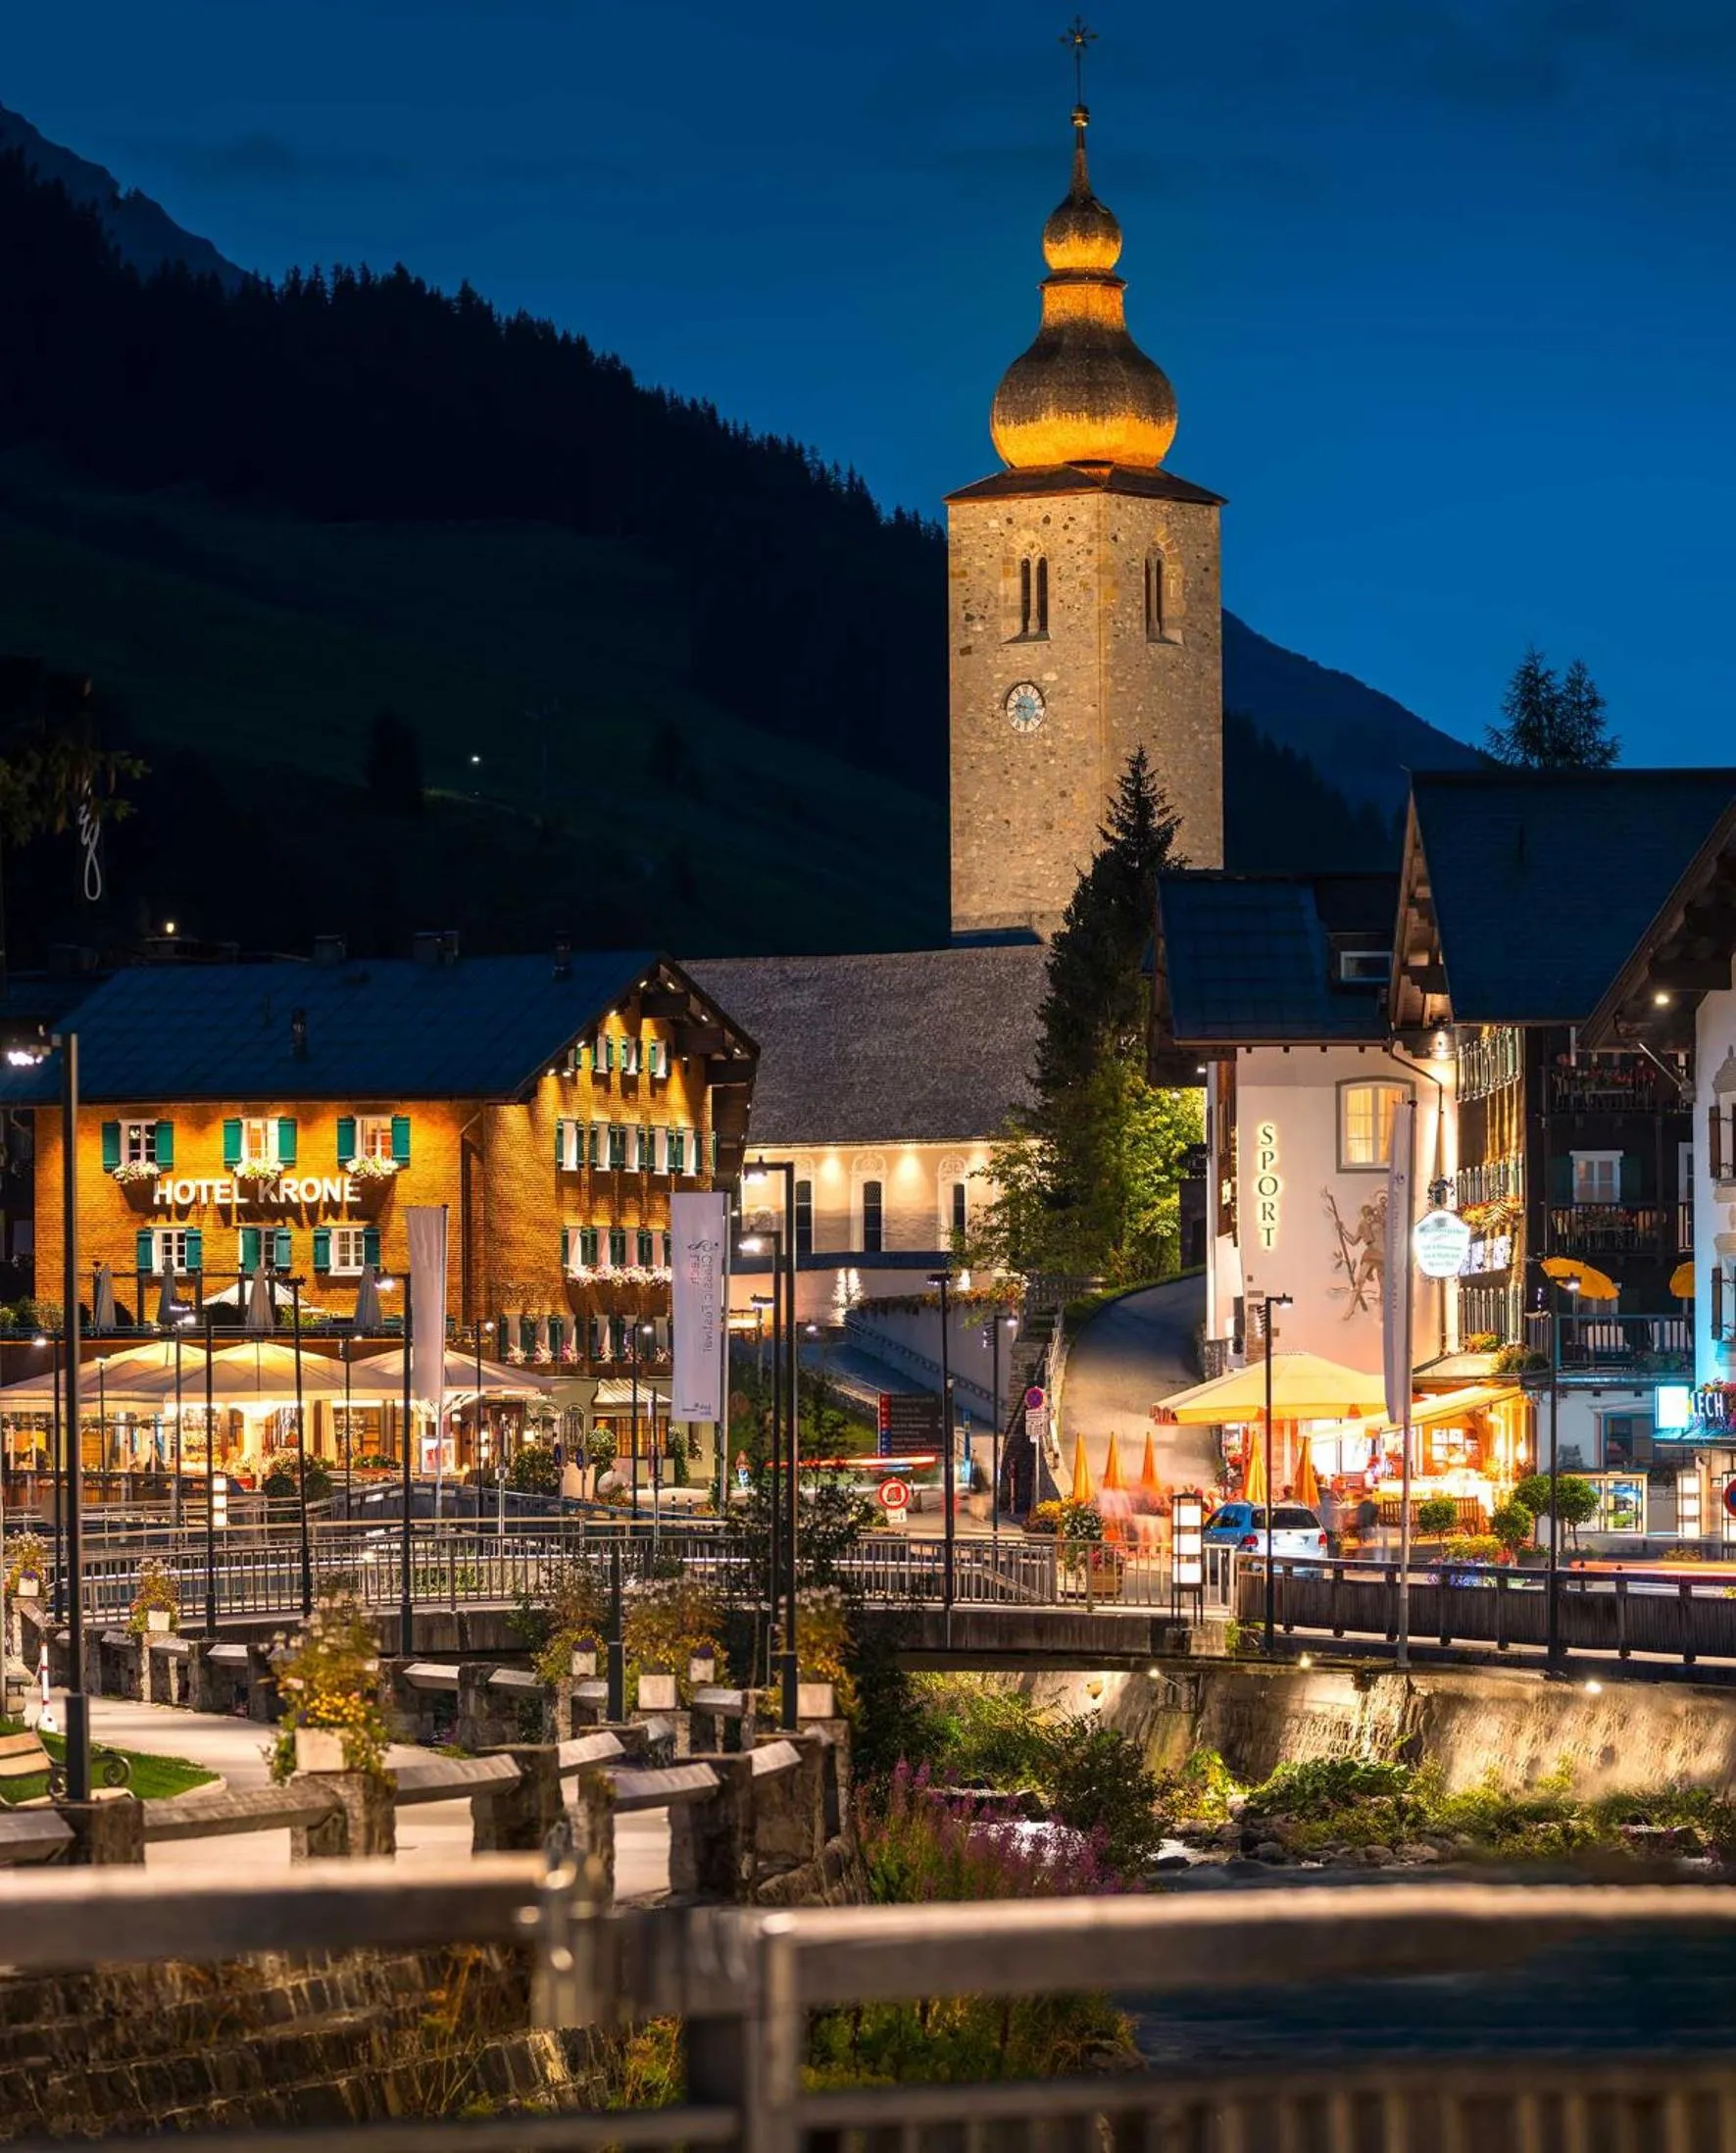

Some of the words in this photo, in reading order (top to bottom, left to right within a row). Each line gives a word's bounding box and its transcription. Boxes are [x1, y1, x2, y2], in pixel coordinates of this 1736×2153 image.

[153, 1178, 249, 1205] HOTEL
[258, 1177, 362, 1203] KRONE
[1258, 1125, 1278, 1247] SPORT
[1690, 1391, 1724, 1418] LECH
